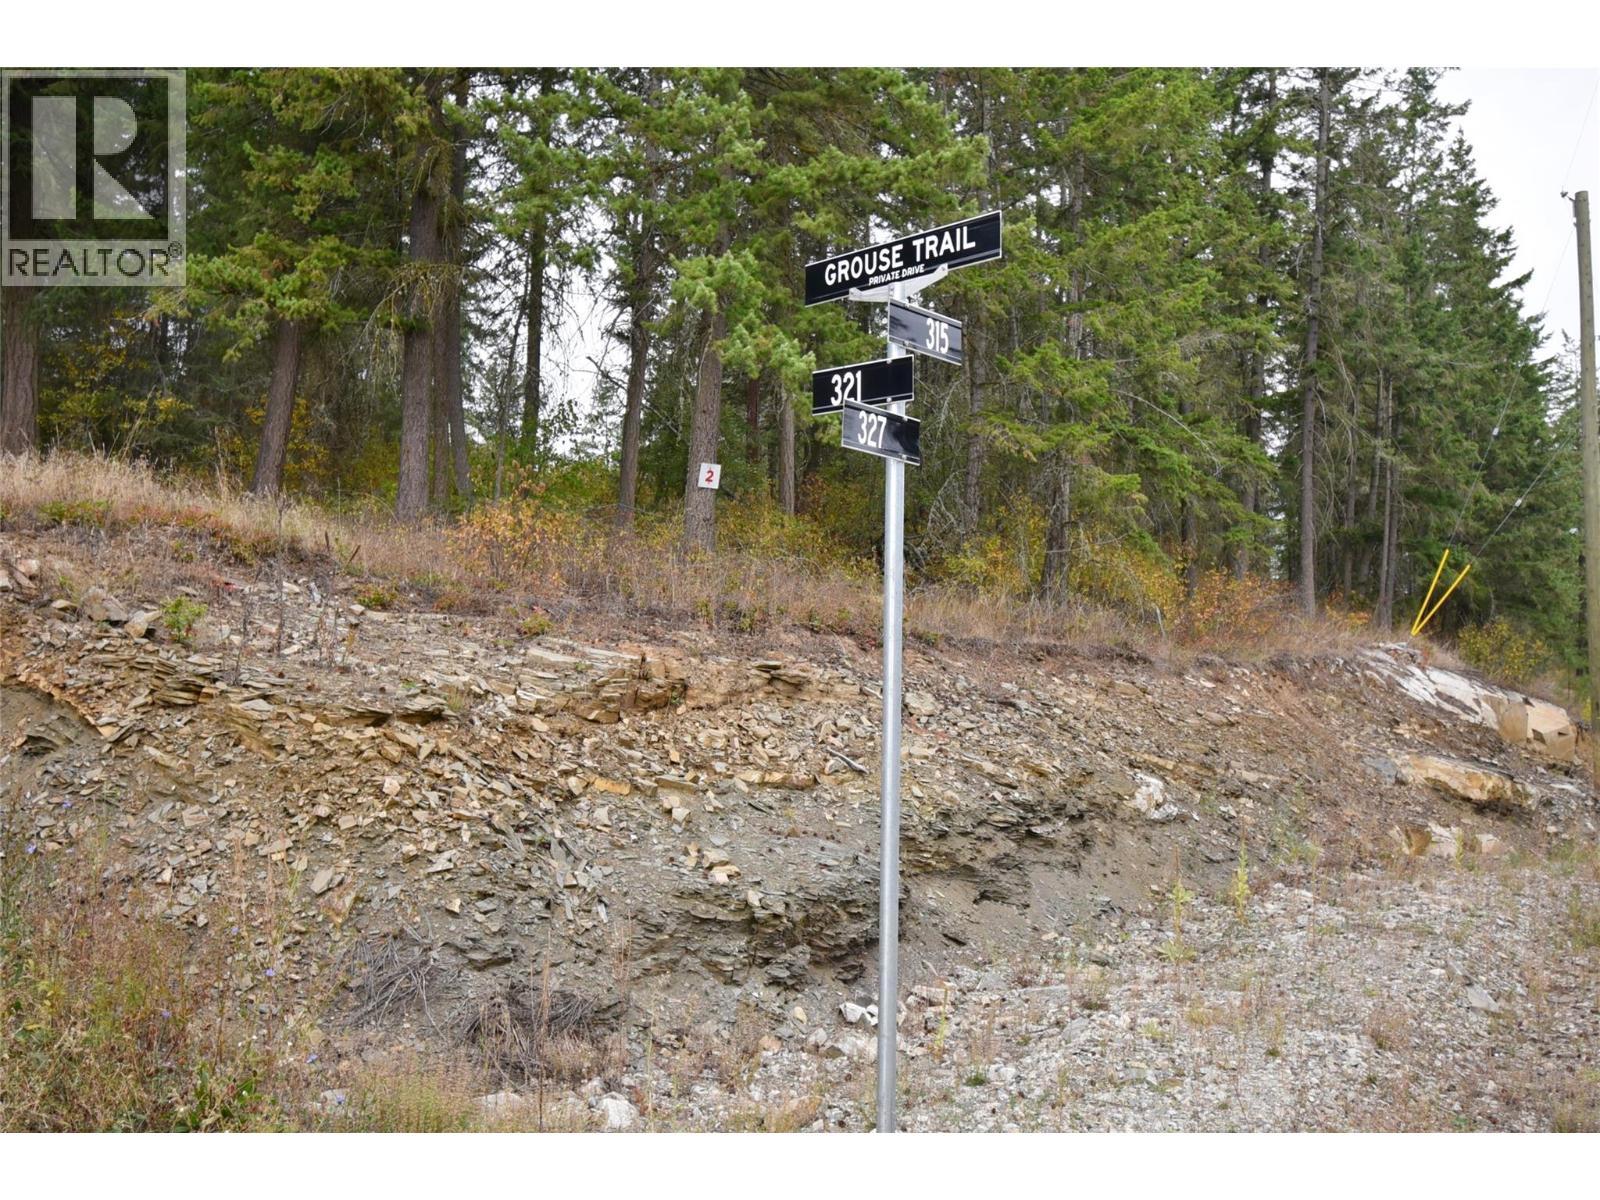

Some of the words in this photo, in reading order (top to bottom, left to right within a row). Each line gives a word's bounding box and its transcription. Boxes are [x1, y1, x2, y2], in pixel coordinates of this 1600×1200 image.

[824, 244, 904, 286] GROUSE
[912, 225, 976, 262] TRAIL
[868, 269, 901, 286] PRIVATE
[901, 263, 925, 279] DRIVE
[925, 317, 949, 354] 315
[830, 370, 862, 406] 321
[857, 410, 887, 449] 327
[705, 470, 714, 482] 2
